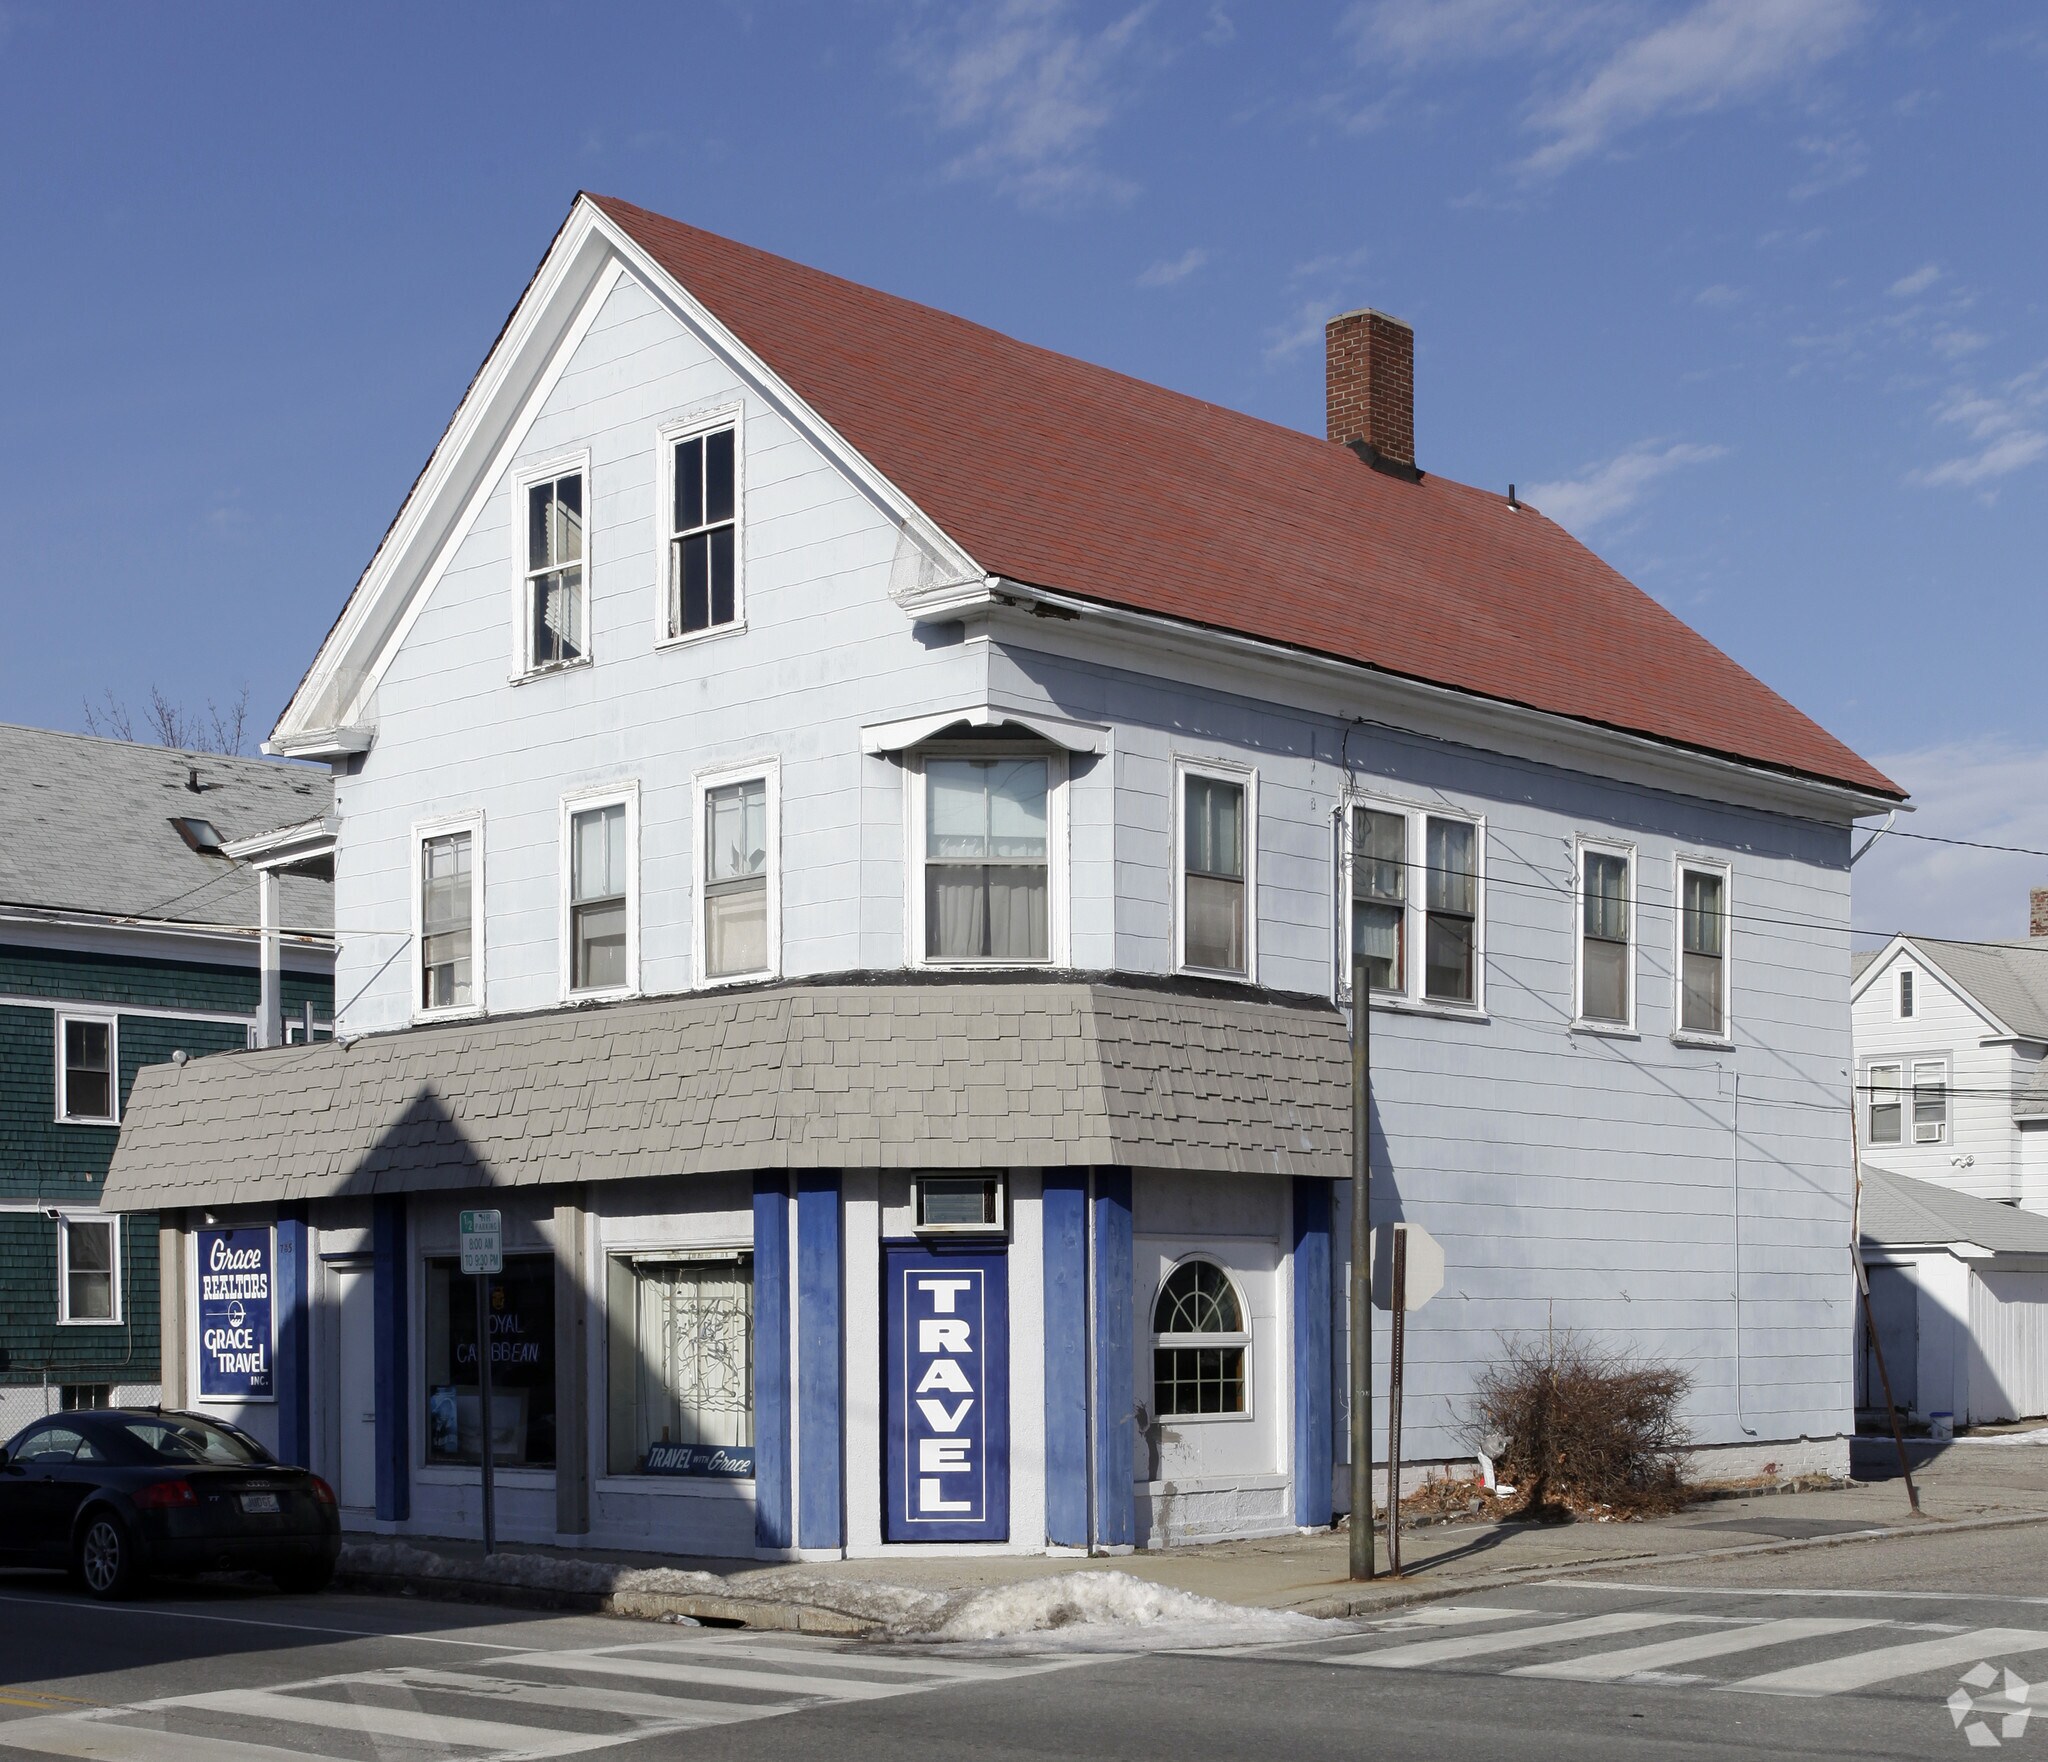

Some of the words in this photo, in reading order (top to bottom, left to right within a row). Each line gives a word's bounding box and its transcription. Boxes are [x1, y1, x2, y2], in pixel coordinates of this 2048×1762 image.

[475, 1222, 497, 1231] PARKING
[210, 1239, 261, 1272] Grace
[469, 1238, 482, 1250] 8:00
[484, 1238, 493, 1249] AM
[465, 1254, 473, 1266] TO
[490, 1254, 499, 1266] PM
[203, 1274, 268, 1300] REALTORS
[489, 1314, 524, 1334] OYAL
[204, 1329, 253, 1357] GRACE
[456, 1343, 539, 1364] CABBEAN
[218, 1344, 268, 1373] TRAVEL
[250, 1376, 269, 1386] INC.
[915, 1279, 975, 1512] TRAVEL
[649, 1448, 692, 1469] TRAVEL
[693, 1455, 709, 1463] WITH
[707, 1450, 751, 1473] Grace
